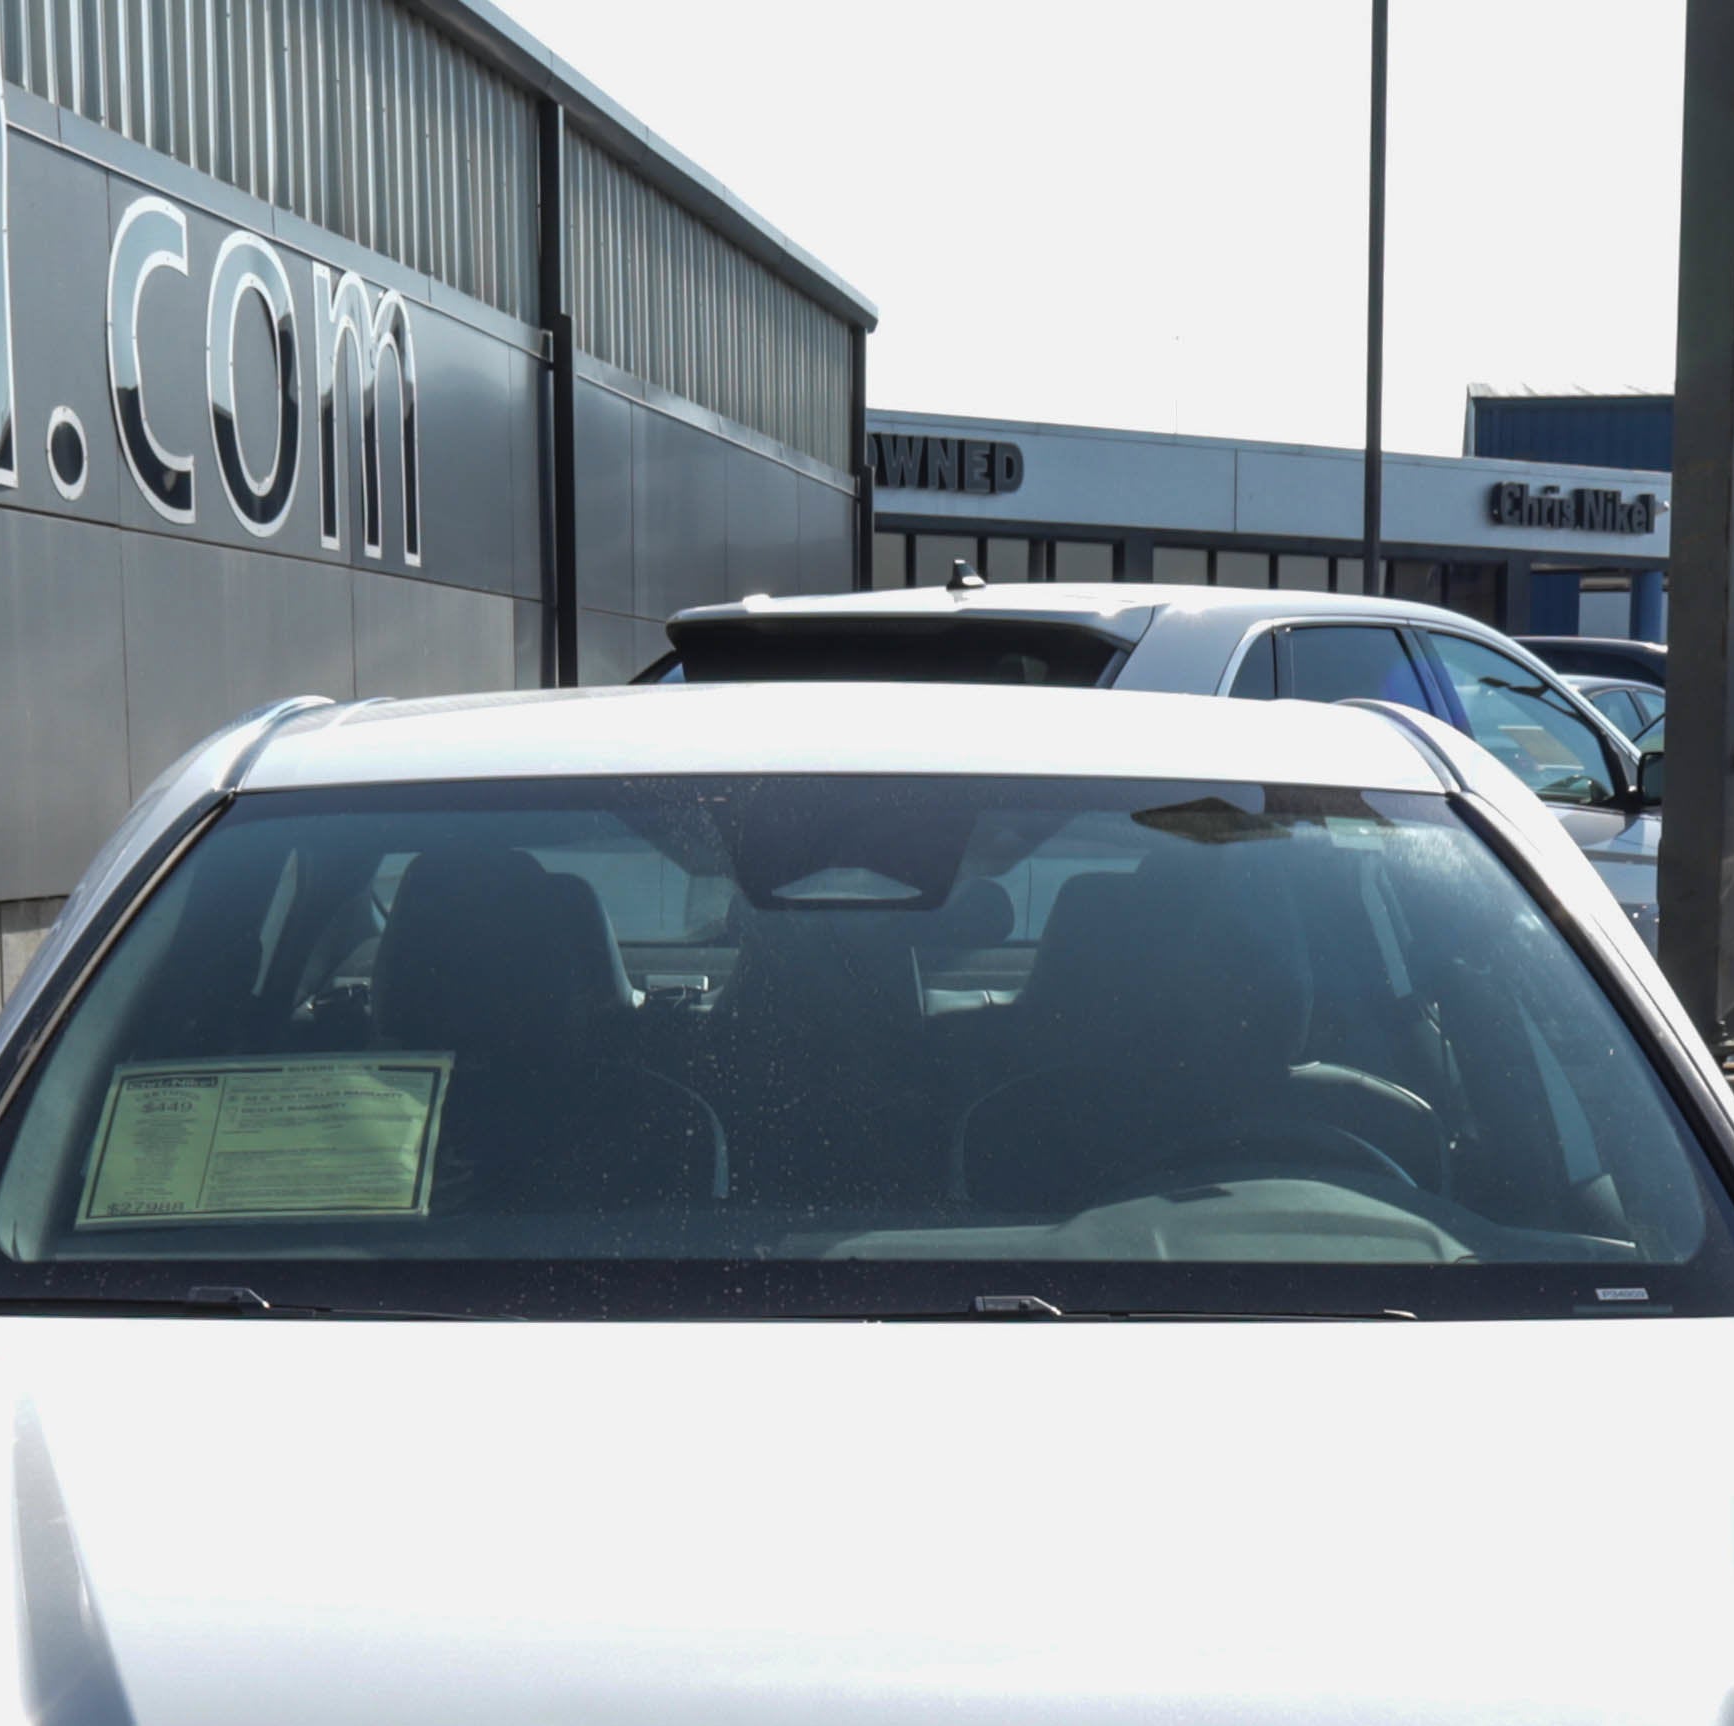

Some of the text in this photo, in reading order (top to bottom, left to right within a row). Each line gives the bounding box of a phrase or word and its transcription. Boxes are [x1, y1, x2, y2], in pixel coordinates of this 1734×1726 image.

[867, 433, 1025, 494] WNED
[1492, 482, 1656, 534] Chris Nikel
